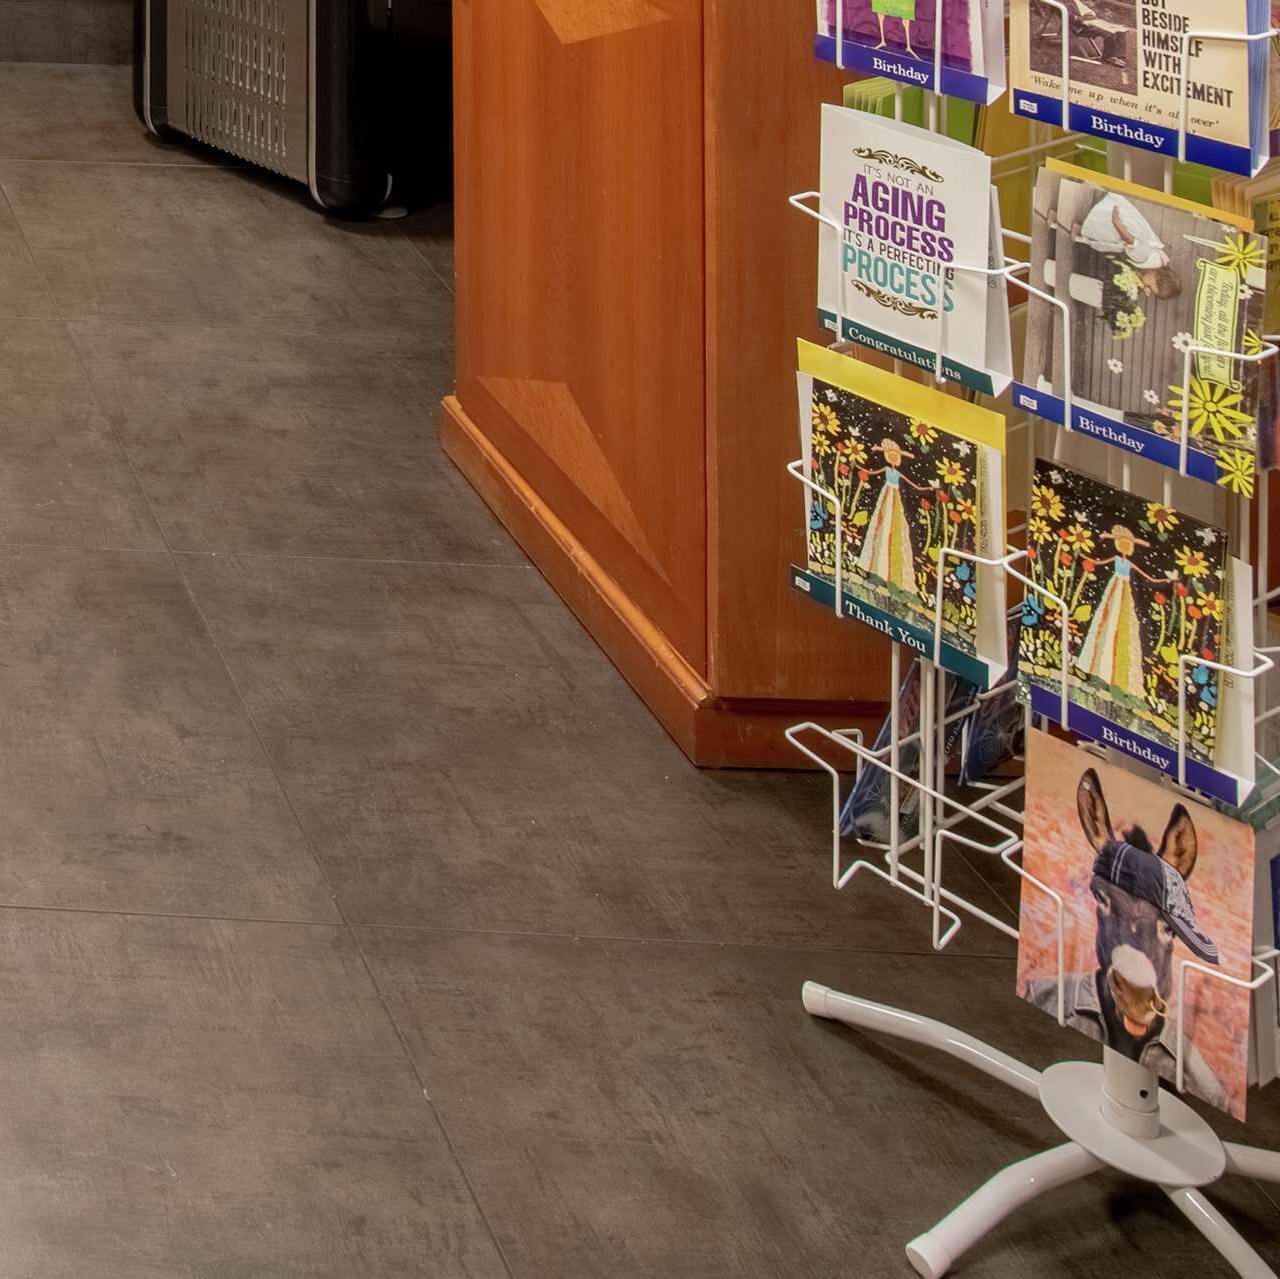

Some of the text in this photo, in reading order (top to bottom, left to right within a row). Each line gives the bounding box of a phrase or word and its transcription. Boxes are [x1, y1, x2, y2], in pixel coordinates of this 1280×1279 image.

[1142, 9, 1189, 33] BESIDE
[1142, 29, 1203, 58] HIMSLF
[1143, 49, 1182, 74] WITH
[872, 57, 929, 84] Birthday
[1143, 70, 1233, 108] EXCITEMENT
[1068, 87, 1083, 95] me
[1088, 91, 1104, 101] up
[1109, 96, 1138, 109] when
[1144, 102, 1162, 115] it's
[1190, 115, 1220, 128] over'
[1091, 115, 1165, 148] Birthday
[863, 164, 934, 196] IT'S NOT AN
[851, 173, 946, 233] AGING
[843, 200, 954, 263] PROCESS
[843, 228, 862, 248] IT'S
[866, 238, 875, 253] A
[843, 242, 954, 312] PROCESS
[848, 326, 962, 380] Congratulatins
[1078, 415, 1145, 453] Birthday
[845, 599, 927, 654] Thank You
[1101, 726, 1170, 770] Birthday
